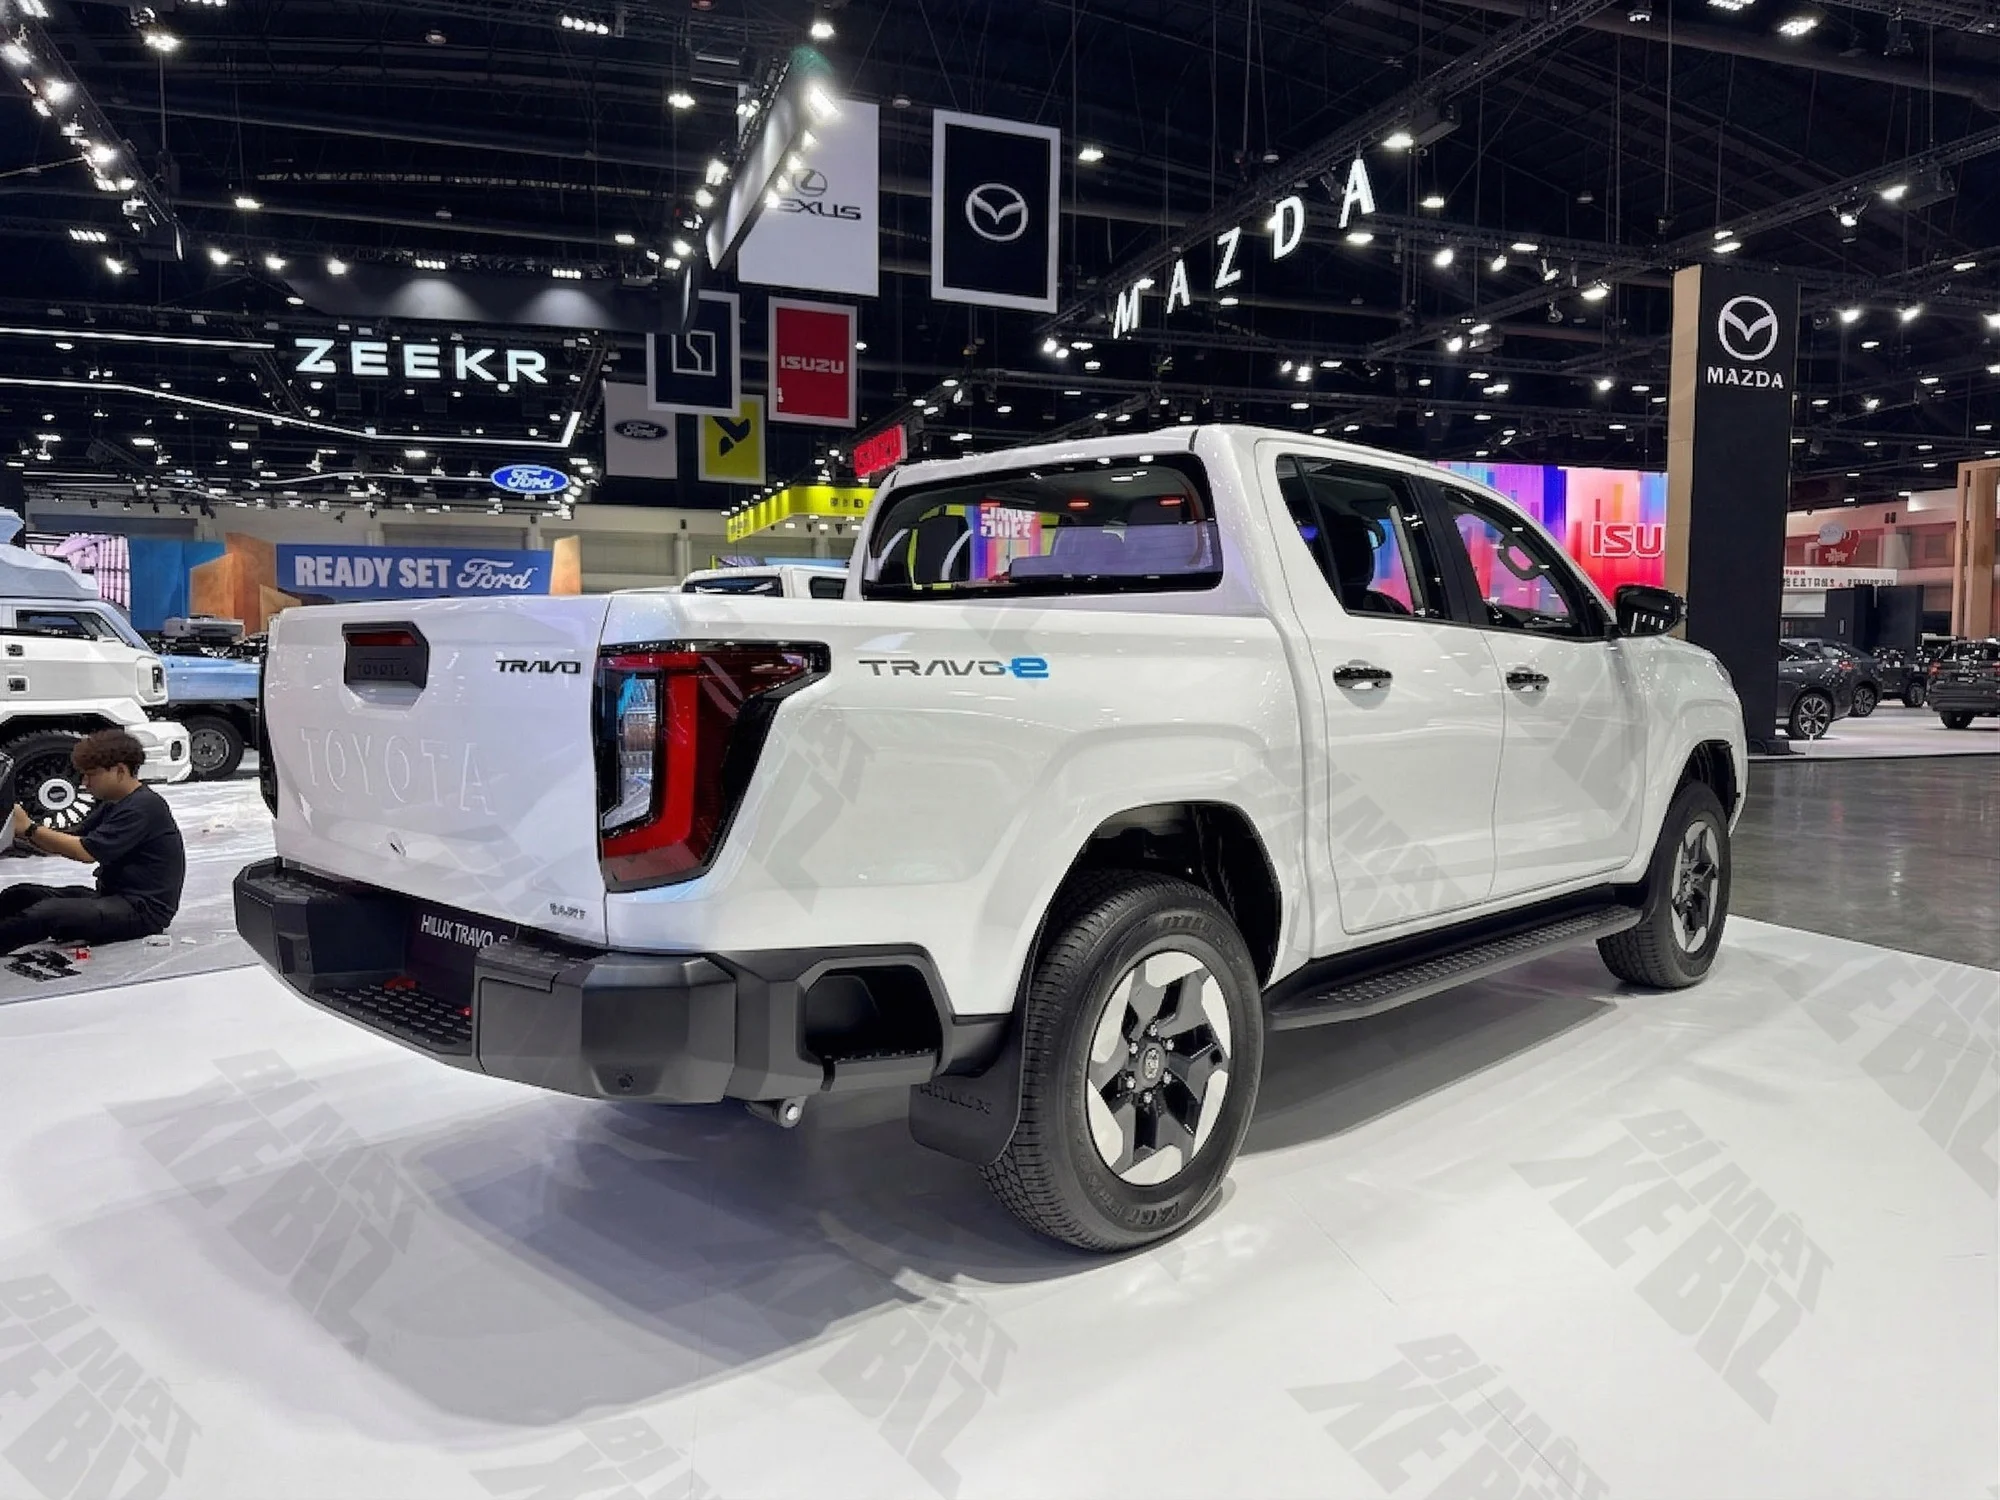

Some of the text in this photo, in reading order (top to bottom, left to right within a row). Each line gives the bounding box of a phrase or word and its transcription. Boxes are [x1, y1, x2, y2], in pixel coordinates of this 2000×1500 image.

[777, 197, 862, 220] EXUS
[1112, 158, 1376, 340] MAZDA
[294, 337, 548, 385] ZEEKR
[780, 355, 845, 375] ISUZU
[1706, 366, 1785, 391] MAZDA
[506, 468, 555, 489] Ford
[294, 554, 538, 591] READY SET Ford
[495, 660, 581, 675] TRAVO
[300, 726, 498, 817] TOYOTA
[420, 913, 454, 940] HILUX
